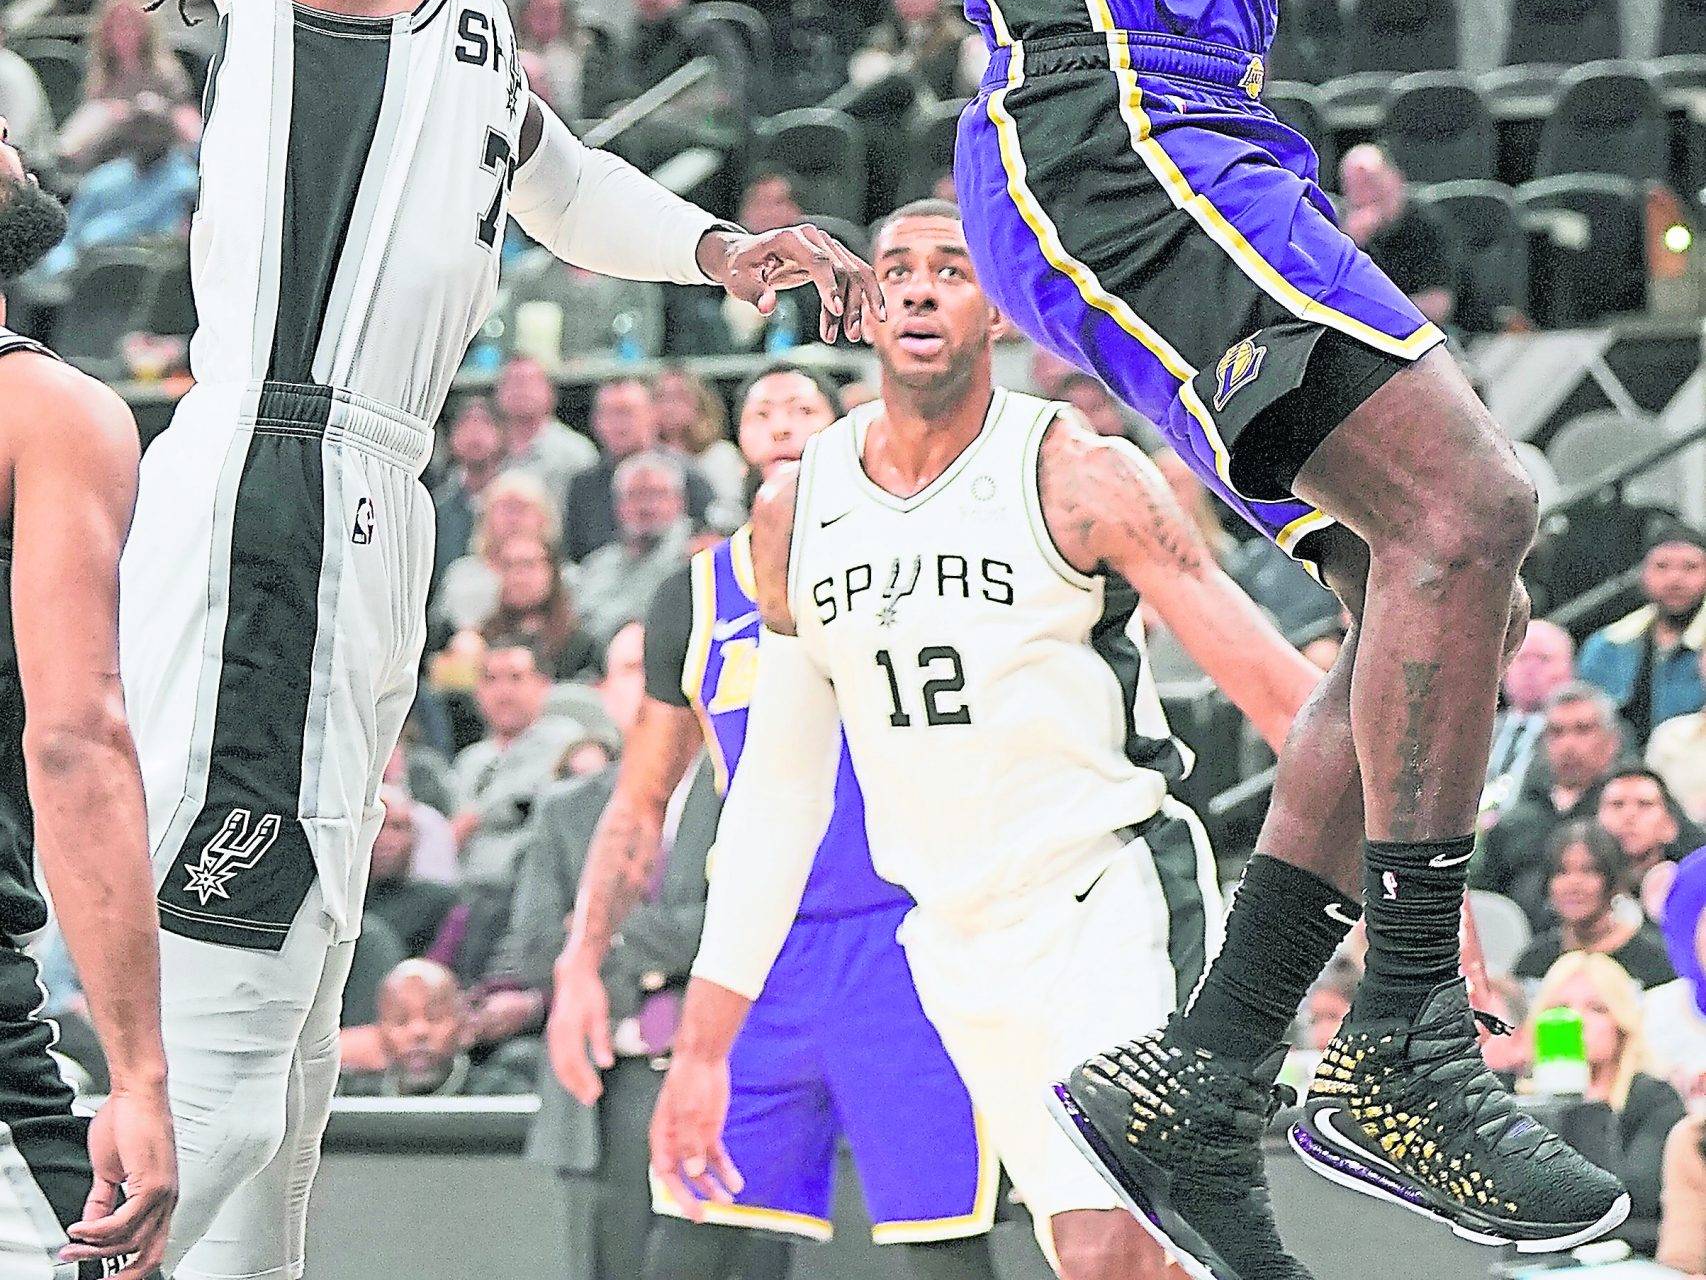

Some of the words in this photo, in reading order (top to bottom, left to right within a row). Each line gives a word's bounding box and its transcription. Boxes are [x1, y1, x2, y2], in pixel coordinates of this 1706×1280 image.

[474, 124, 517, 254] 7
[812, 553, 1014, 627] SPURS
[875, 645, 972, 727] 12
